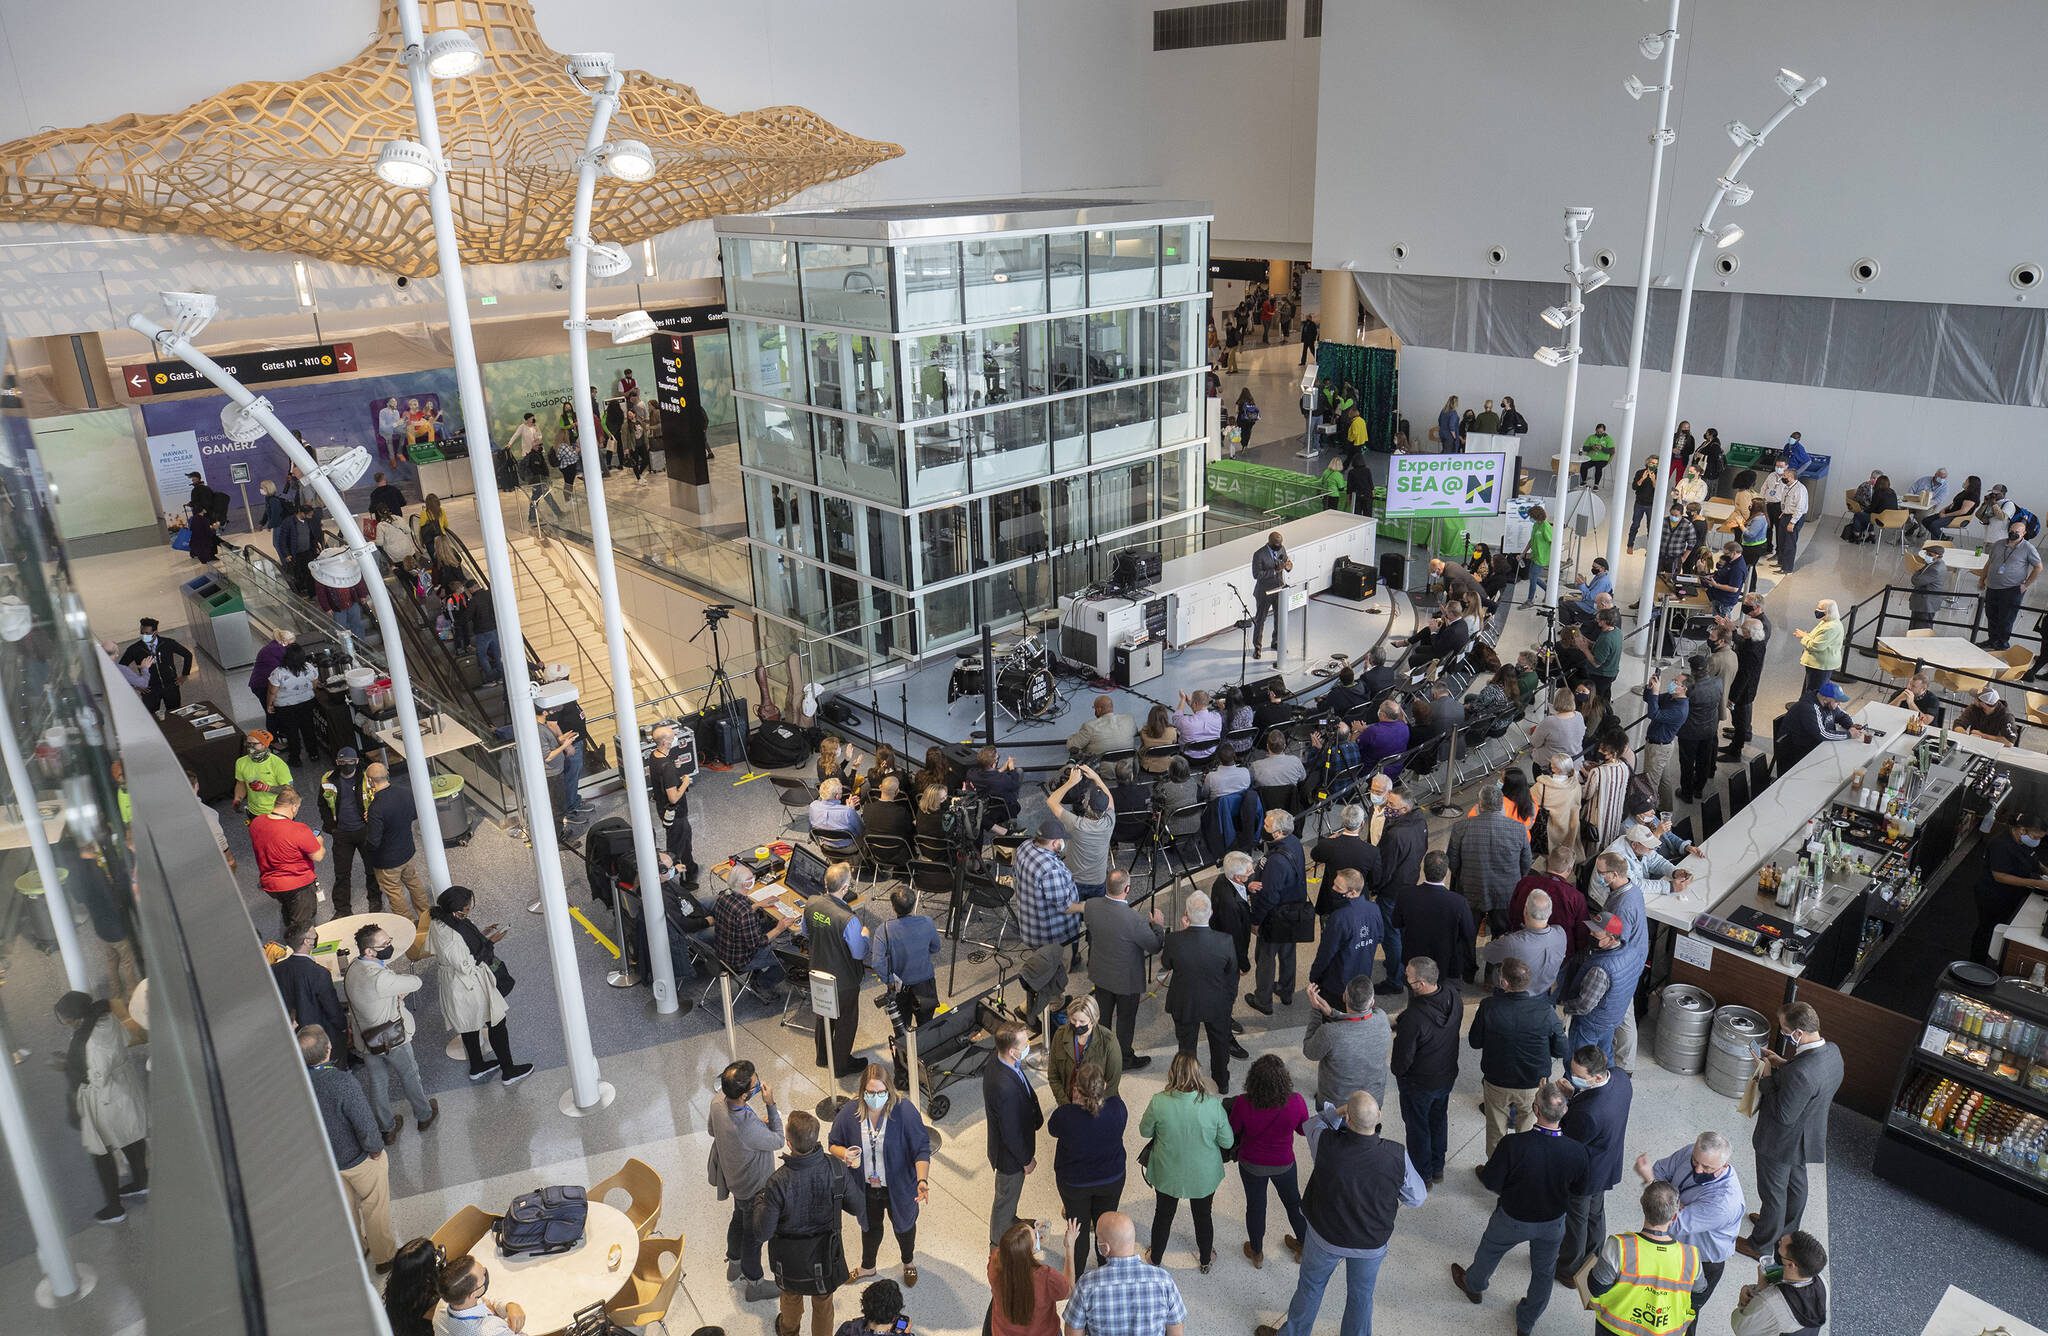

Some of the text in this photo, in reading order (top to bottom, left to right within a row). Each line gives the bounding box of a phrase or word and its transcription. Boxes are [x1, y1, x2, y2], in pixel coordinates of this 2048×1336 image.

[665, 317, 675, 326] N11
[680, 316, 692, 324] N20
[262, 361, 285, 372] Gates
[286, 359, 298, 369] N1
[304, 357, 320, 367] N10
[169, 371, 195, 382] Gates
[222, 366, 237, 375] 20
[203, 439, 257, 455] GAMERZ
[1398, 457, 1495, 475] Experience
[1207, 475, 1241, 494] SEA
[1396, 476, 1439, 493] SEA
[1274, 488, 1311, 508] SEA
[812, 911, 831, 926] SEA
